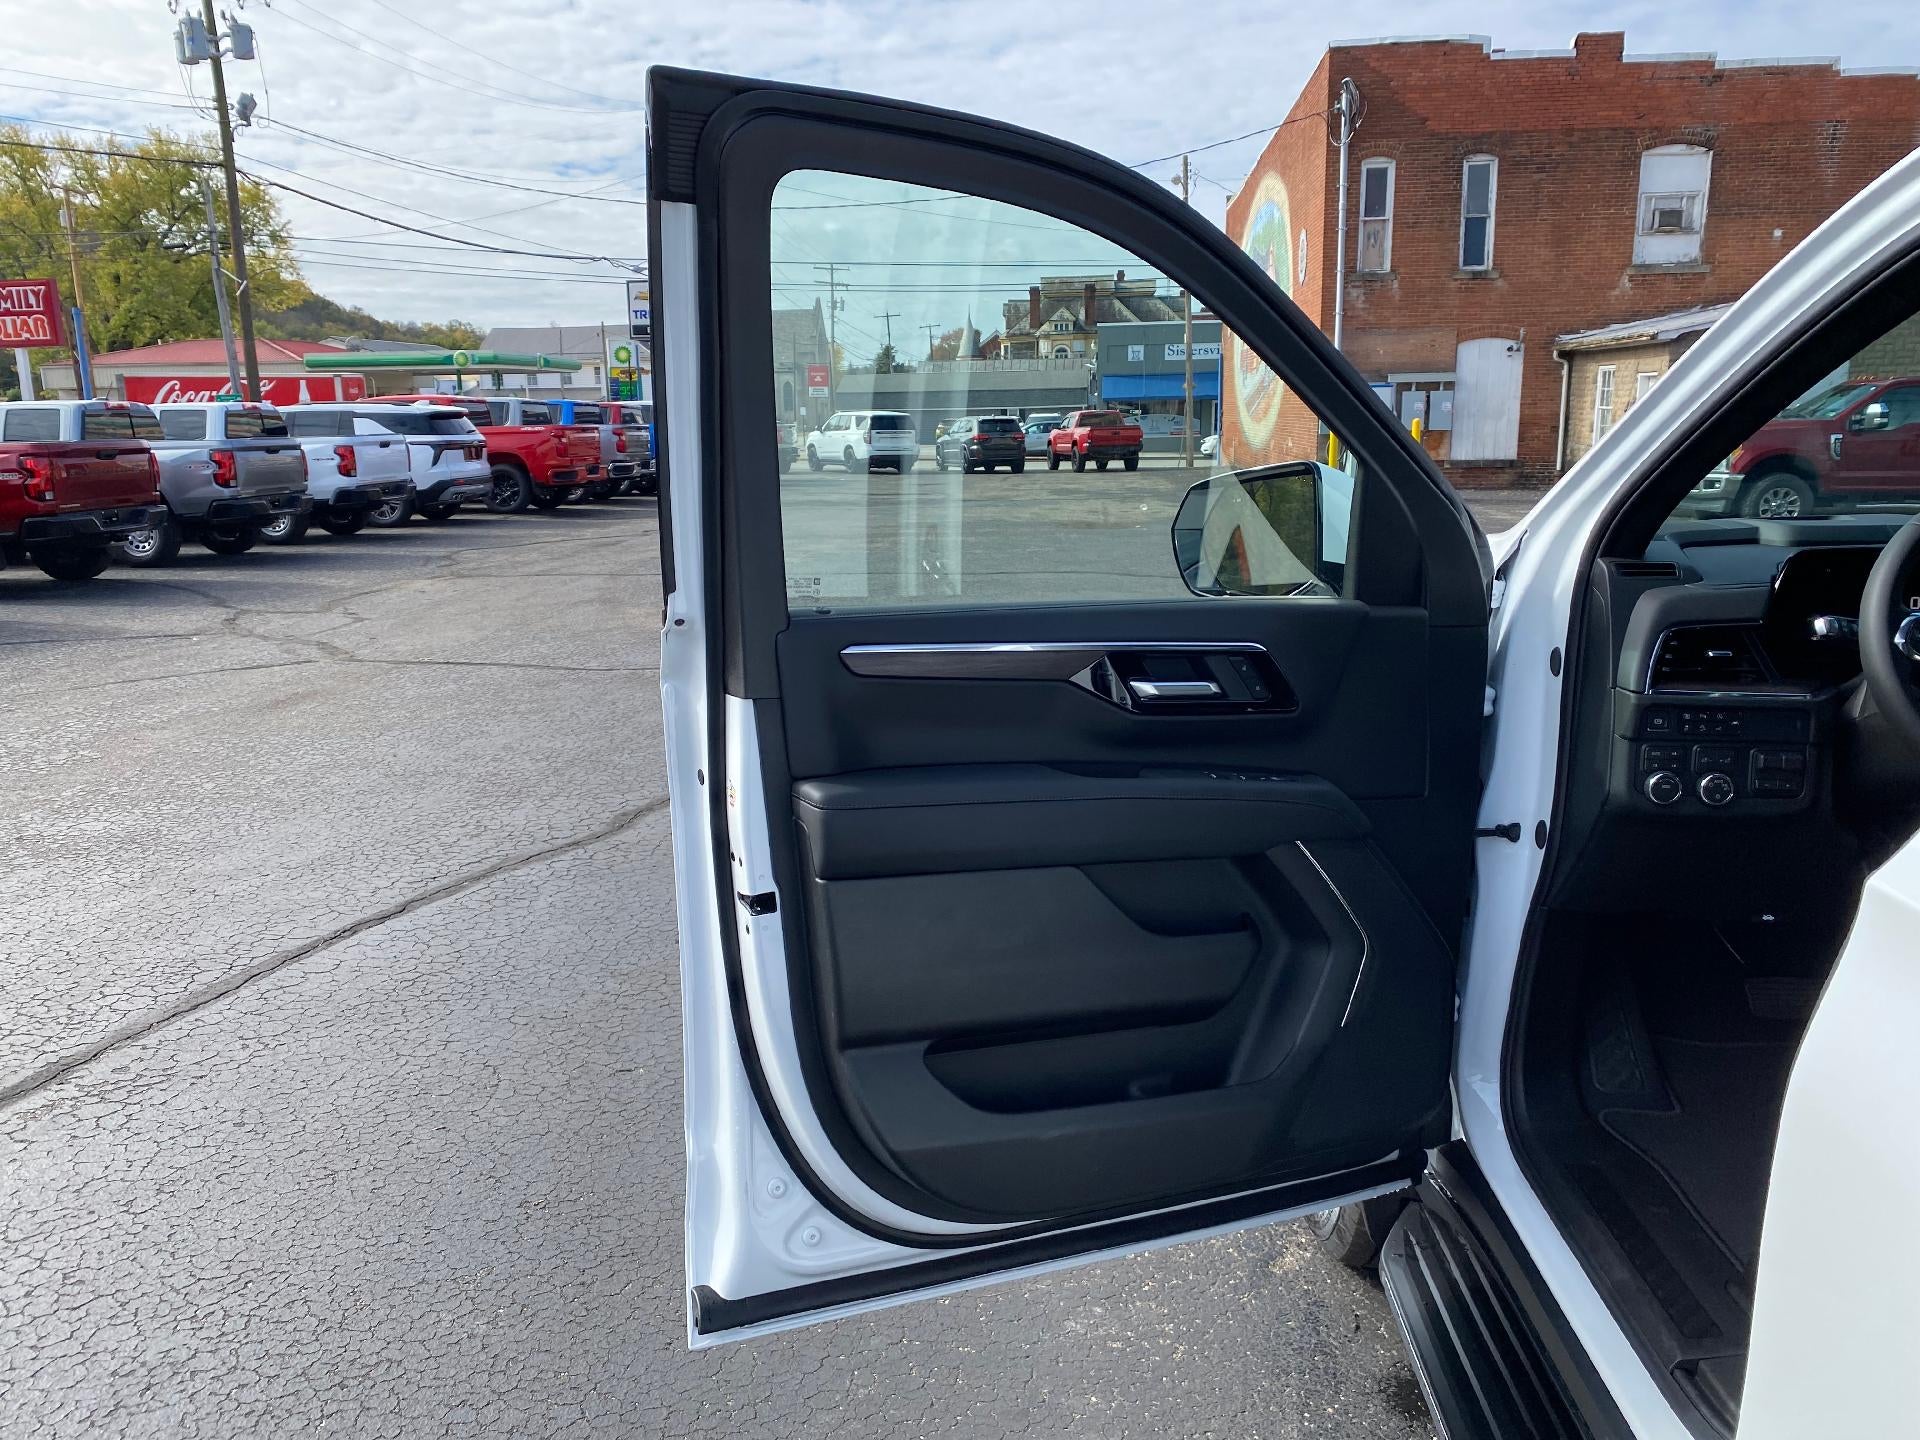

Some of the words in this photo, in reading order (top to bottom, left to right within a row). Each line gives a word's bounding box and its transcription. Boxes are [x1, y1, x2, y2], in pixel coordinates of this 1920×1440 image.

[632, 310, 650, 319] TR
[0, 315, 50, 340] LLAR
[1167, 344, 1220, 356] Sisersvi
